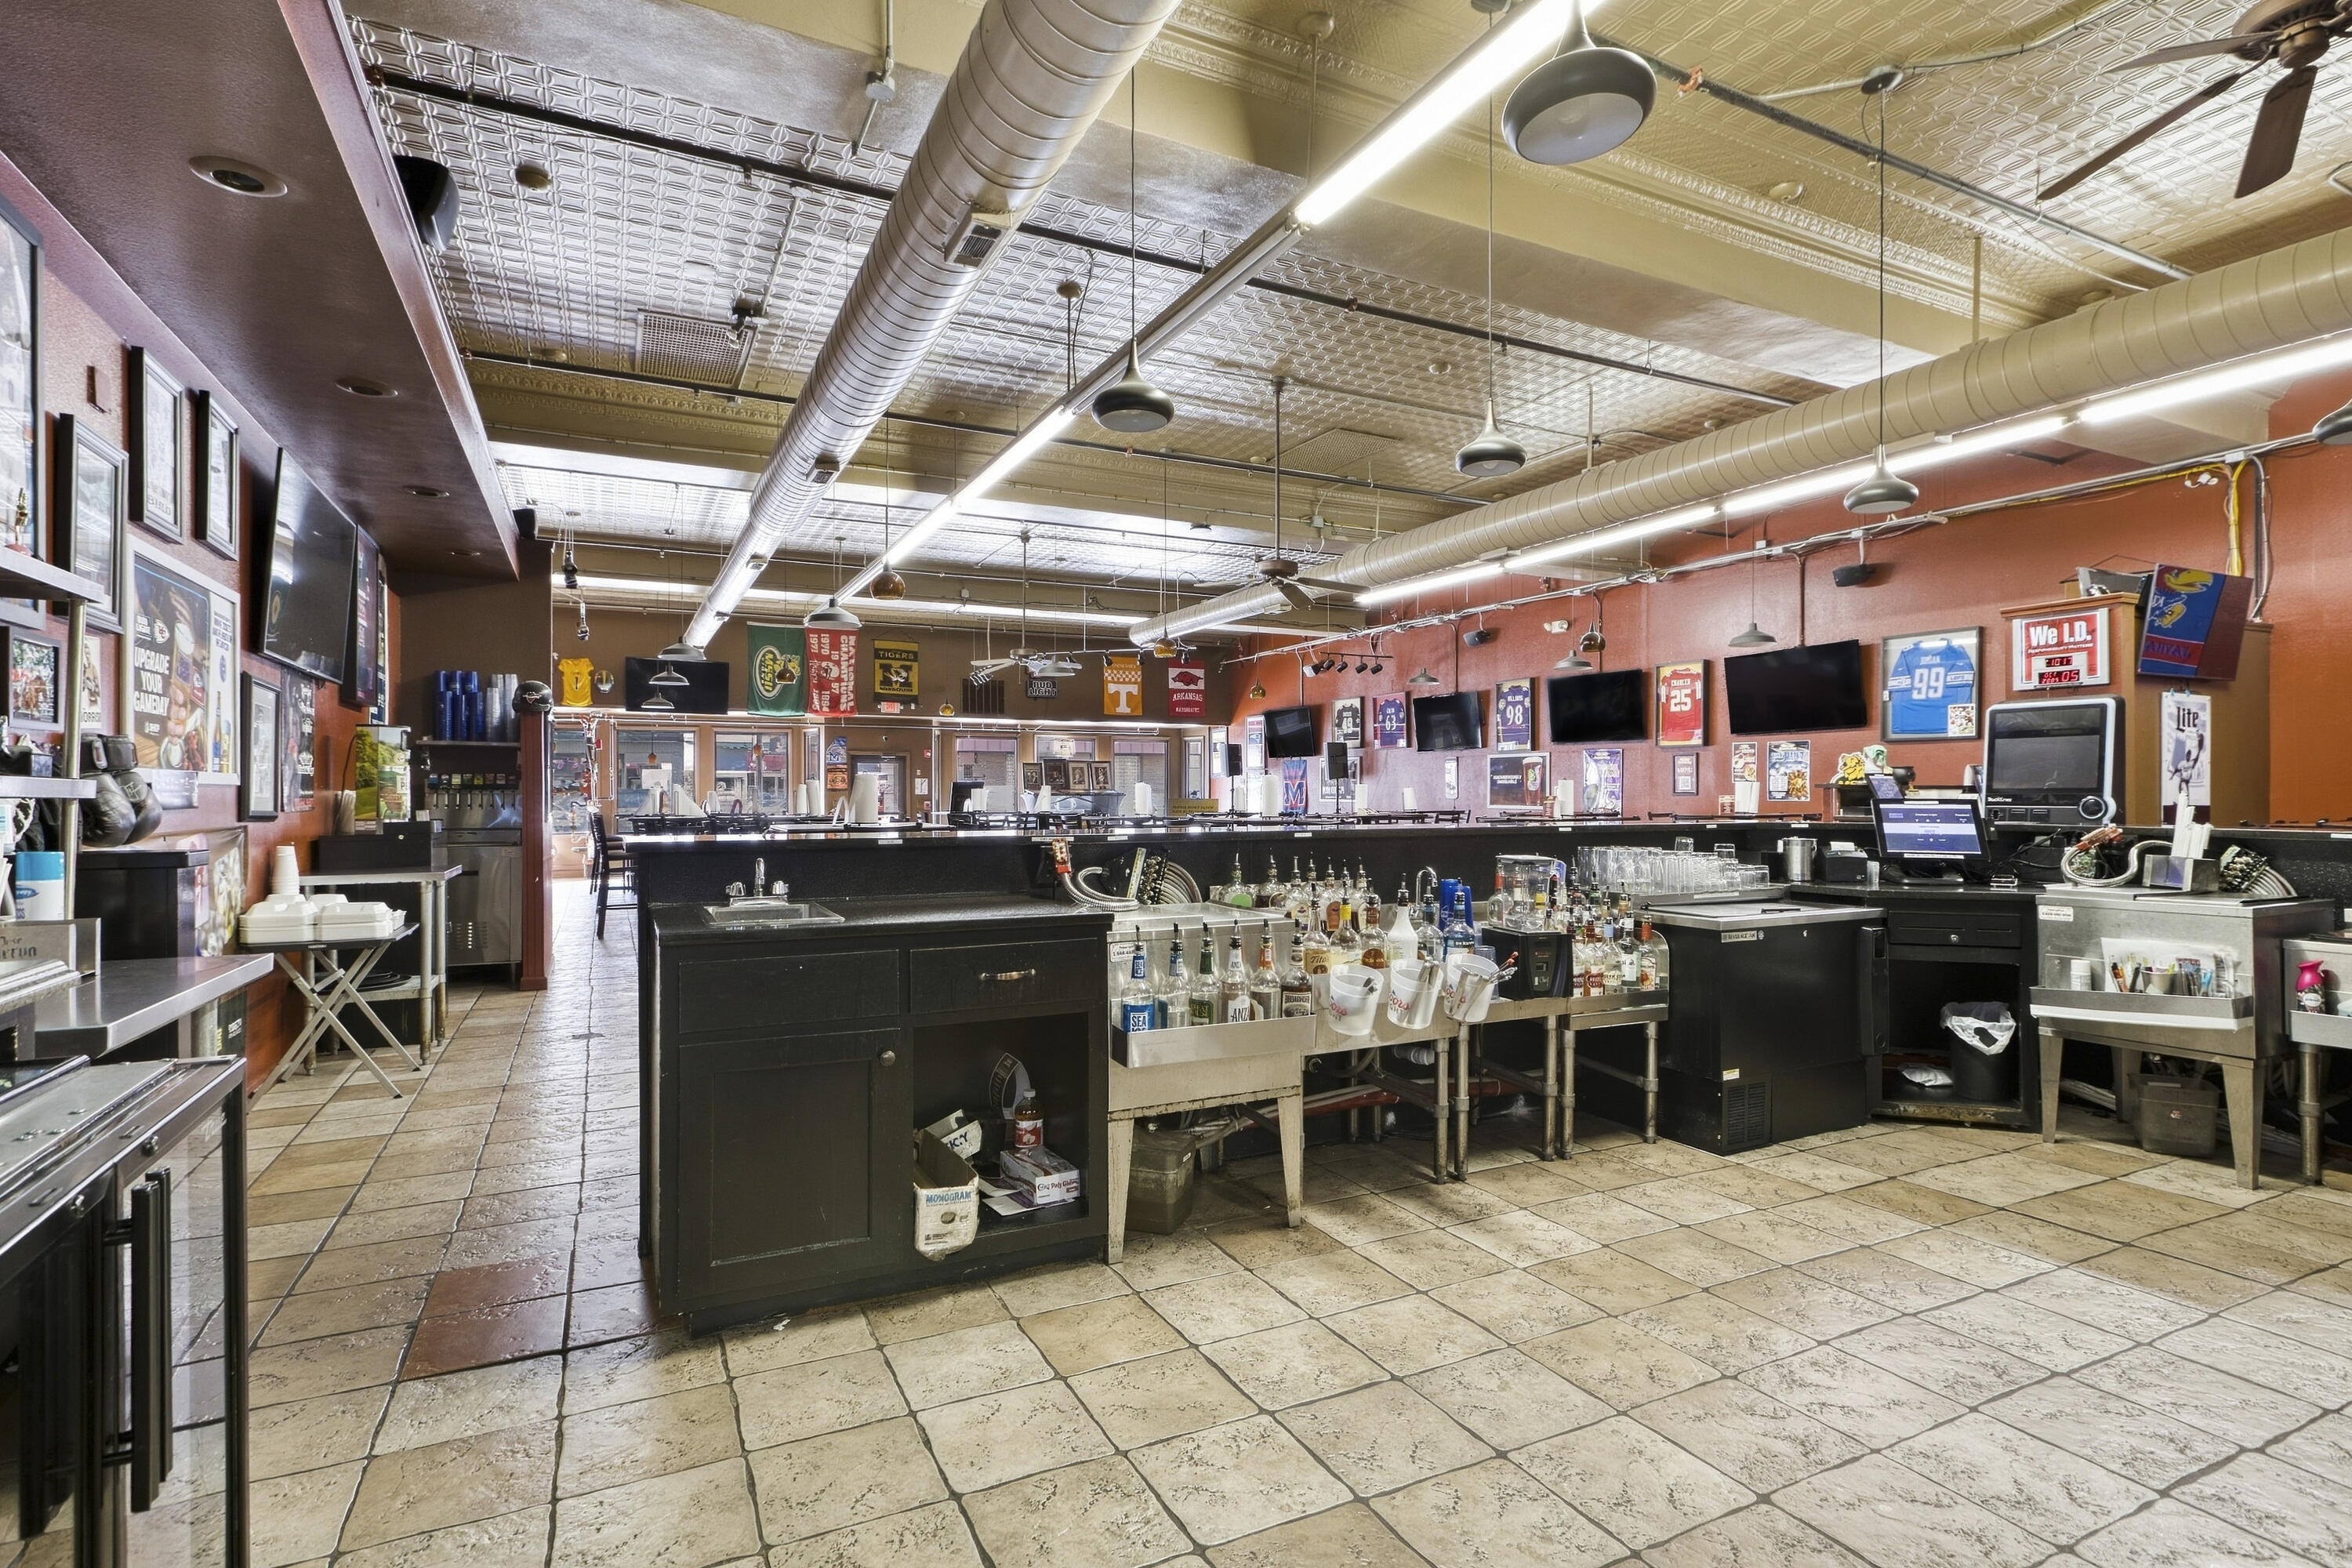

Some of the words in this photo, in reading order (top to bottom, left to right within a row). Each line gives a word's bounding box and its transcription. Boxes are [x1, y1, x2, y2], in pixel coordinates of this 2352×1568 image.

[2029, 625, 2058, 647] We
[2063, 620, 2092, 644] I.D.
[134, 646, 170, 675] UPGRADE
[878, 651, 914, 659] TIGERS
[140, 670, 163, 695] YOUR
[840, 634, 848, 711] CHAMPIONS
[848, 635, 857, 711] NATIONAL
[1911, 666, 1945, 700] 99
[2061, 671, 2078, 682] 05
[133, 691, 170, 717] GAMEDAY
[1029, 688, 1057, 696] LIGHT
[1107, 683, 1139, 713] T
[1172, 692, 1203, 702] ARKANSAS
[1670, 688, 1692, 713] 25
[1385, 714, 1396, 731] 63
[1506, 704, 1523, 726] 98
[2176, 706, 2199, 733] Lite
[1283, 780, 1305, 806] M
[1131, 1015, 1147, 1027] SEA
[1231, 1007, 1250, 1022] ANZ
[925, 1192, 972, 1204] MONOGRAM
